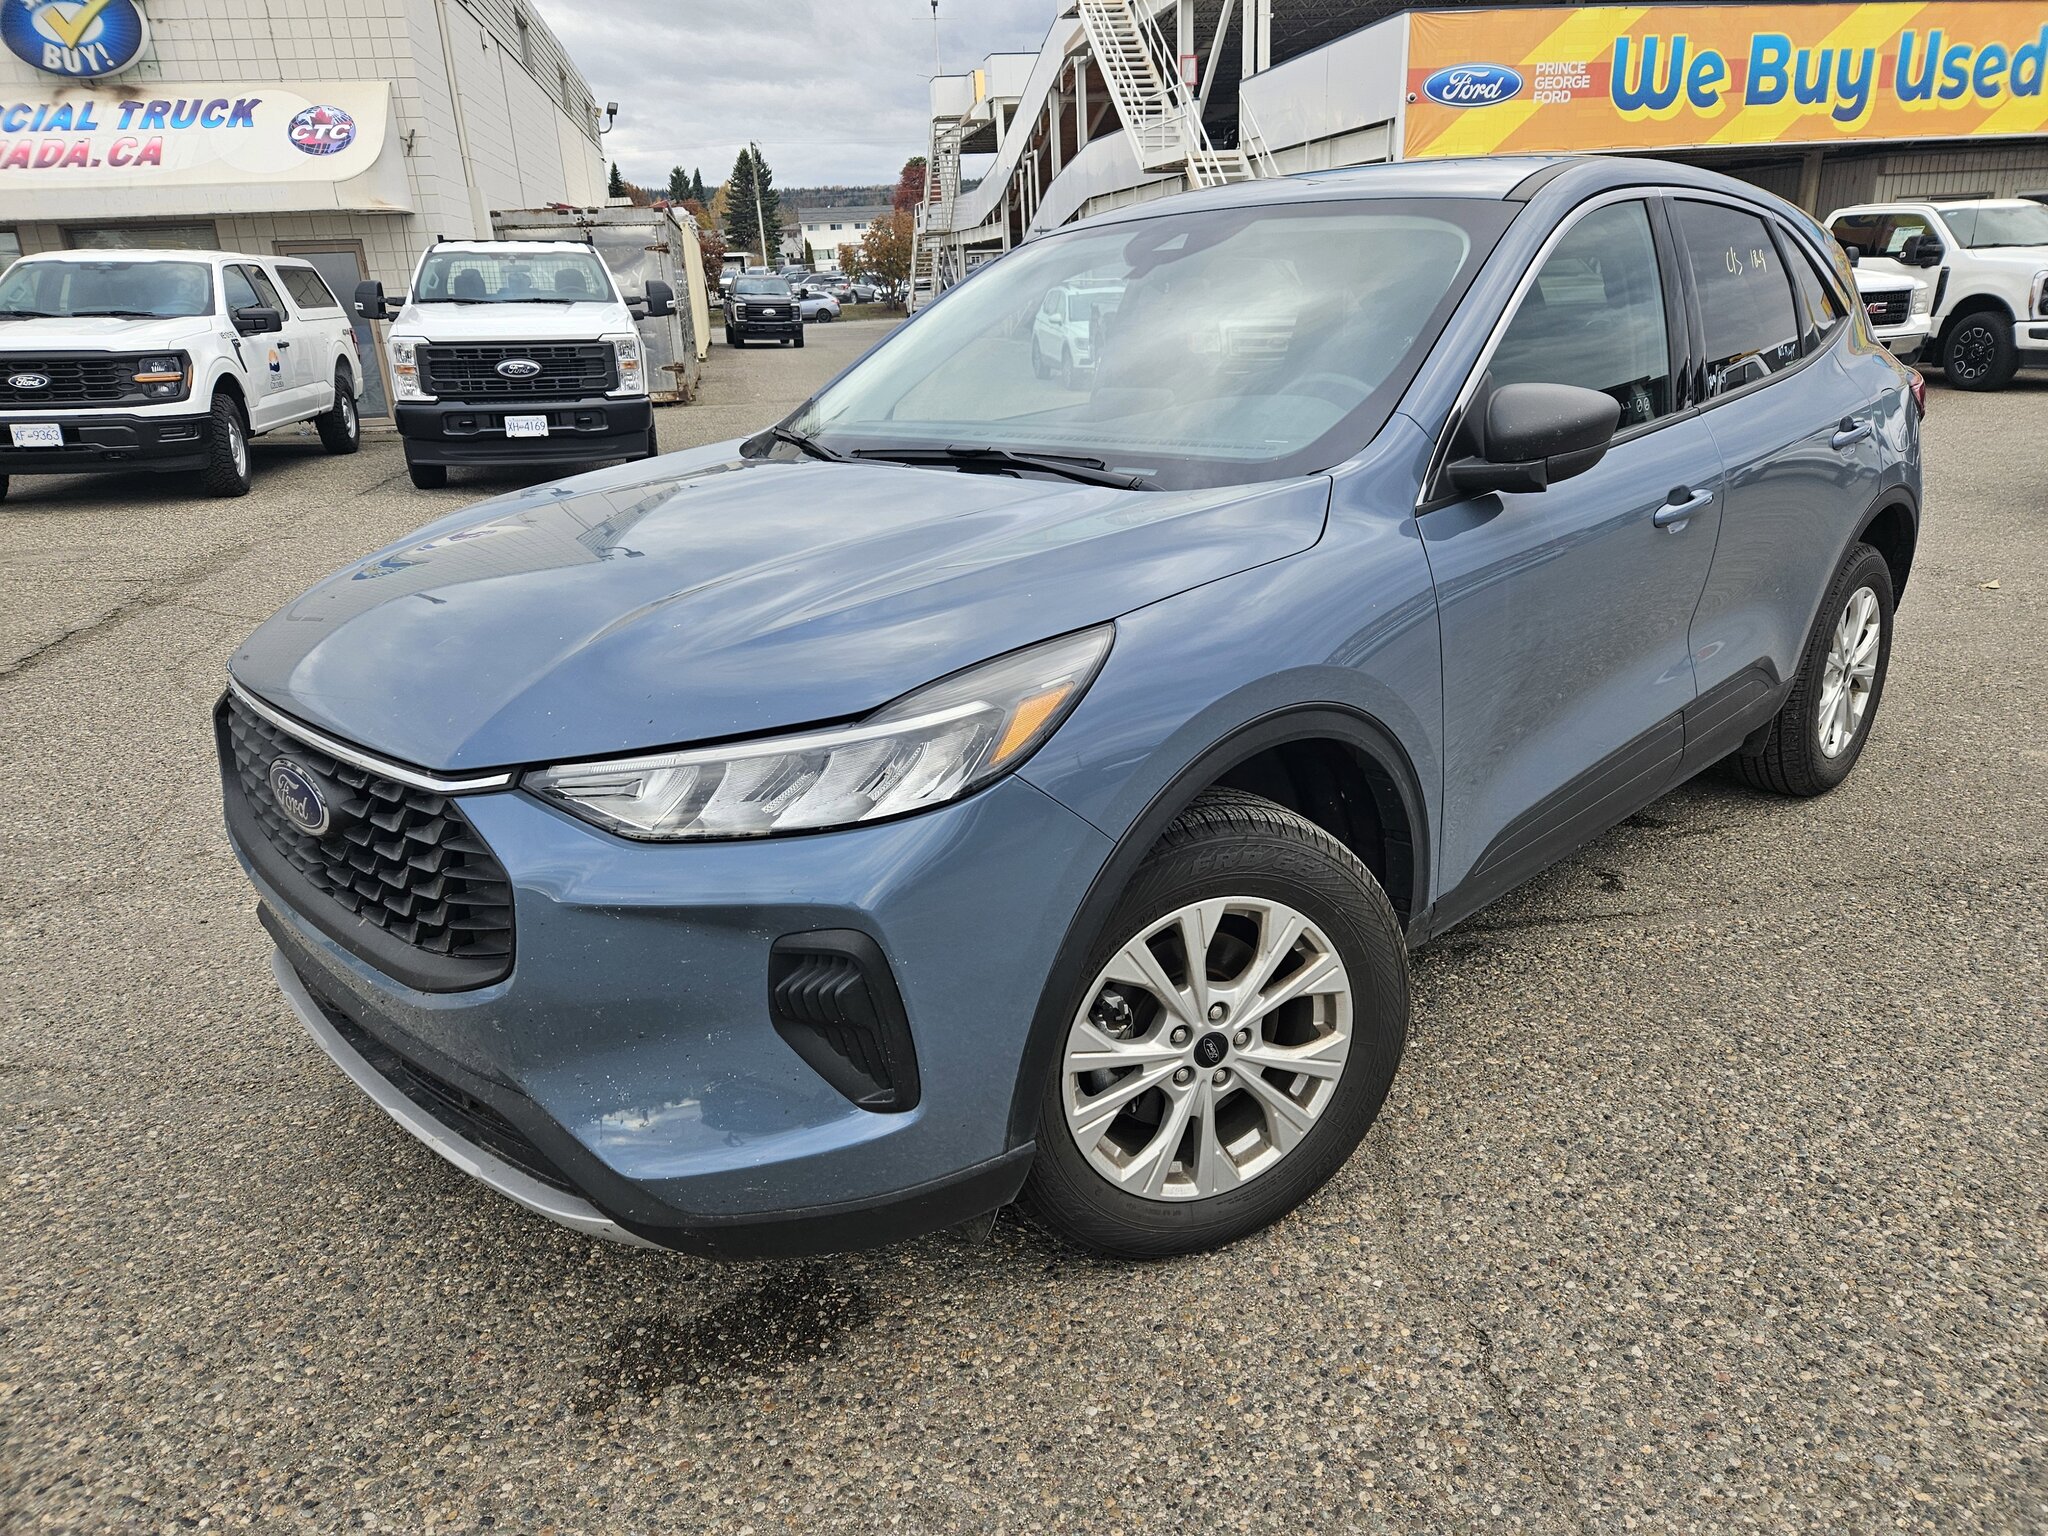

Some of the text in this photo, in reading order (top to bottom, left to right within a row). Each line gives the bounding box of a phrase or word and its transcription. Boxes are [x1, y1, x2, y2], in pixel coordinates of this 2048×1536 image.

[42, 41, 115, 73] BUY!
[1535, 62, 1588, 75] PRINCE
[1610, 22, 2048, 123] We Buy Used
[1442, 70, 1505, 100] Ford
[1534, 75, 1591, 90] GEORGE
[1533, 90, 1572, 104] FORD
[0, 98, 263, 133] CIAL TRUCK
[291, 123, 352, 140] CTC
[0, 135, 163, 169] ADA.CA
[1865, 302, 1888, 314] MC
[508, 364, 531, 374] Ford
[16, 376, 40, 386] Ford
[276, 773, 309, 821] Ford
